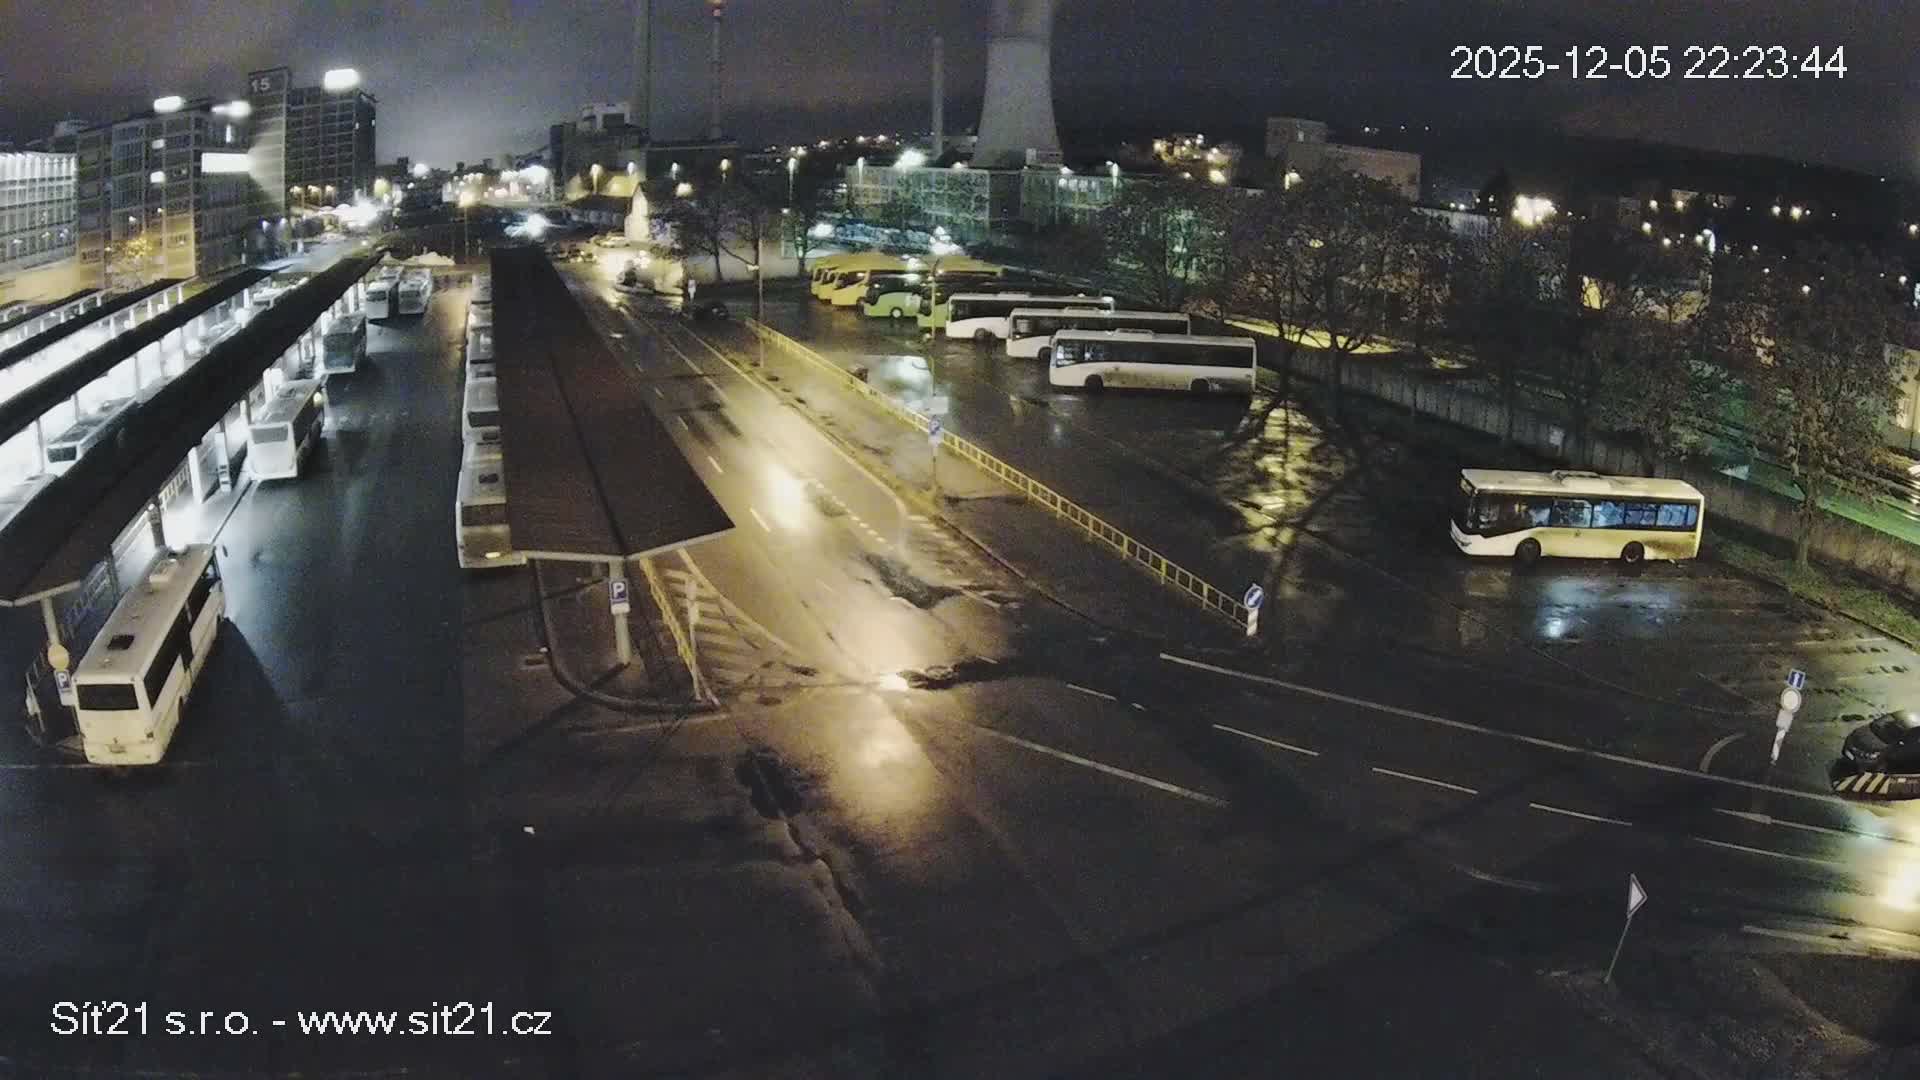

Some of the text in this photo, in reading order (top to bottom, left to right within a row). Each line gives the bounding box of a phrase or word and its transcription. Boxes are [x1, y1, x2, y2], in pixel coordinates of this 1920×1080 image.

[251, 78, 270, 92] 15
[612, 582, 625, 599] P
[58, 672, 67, 688] P
